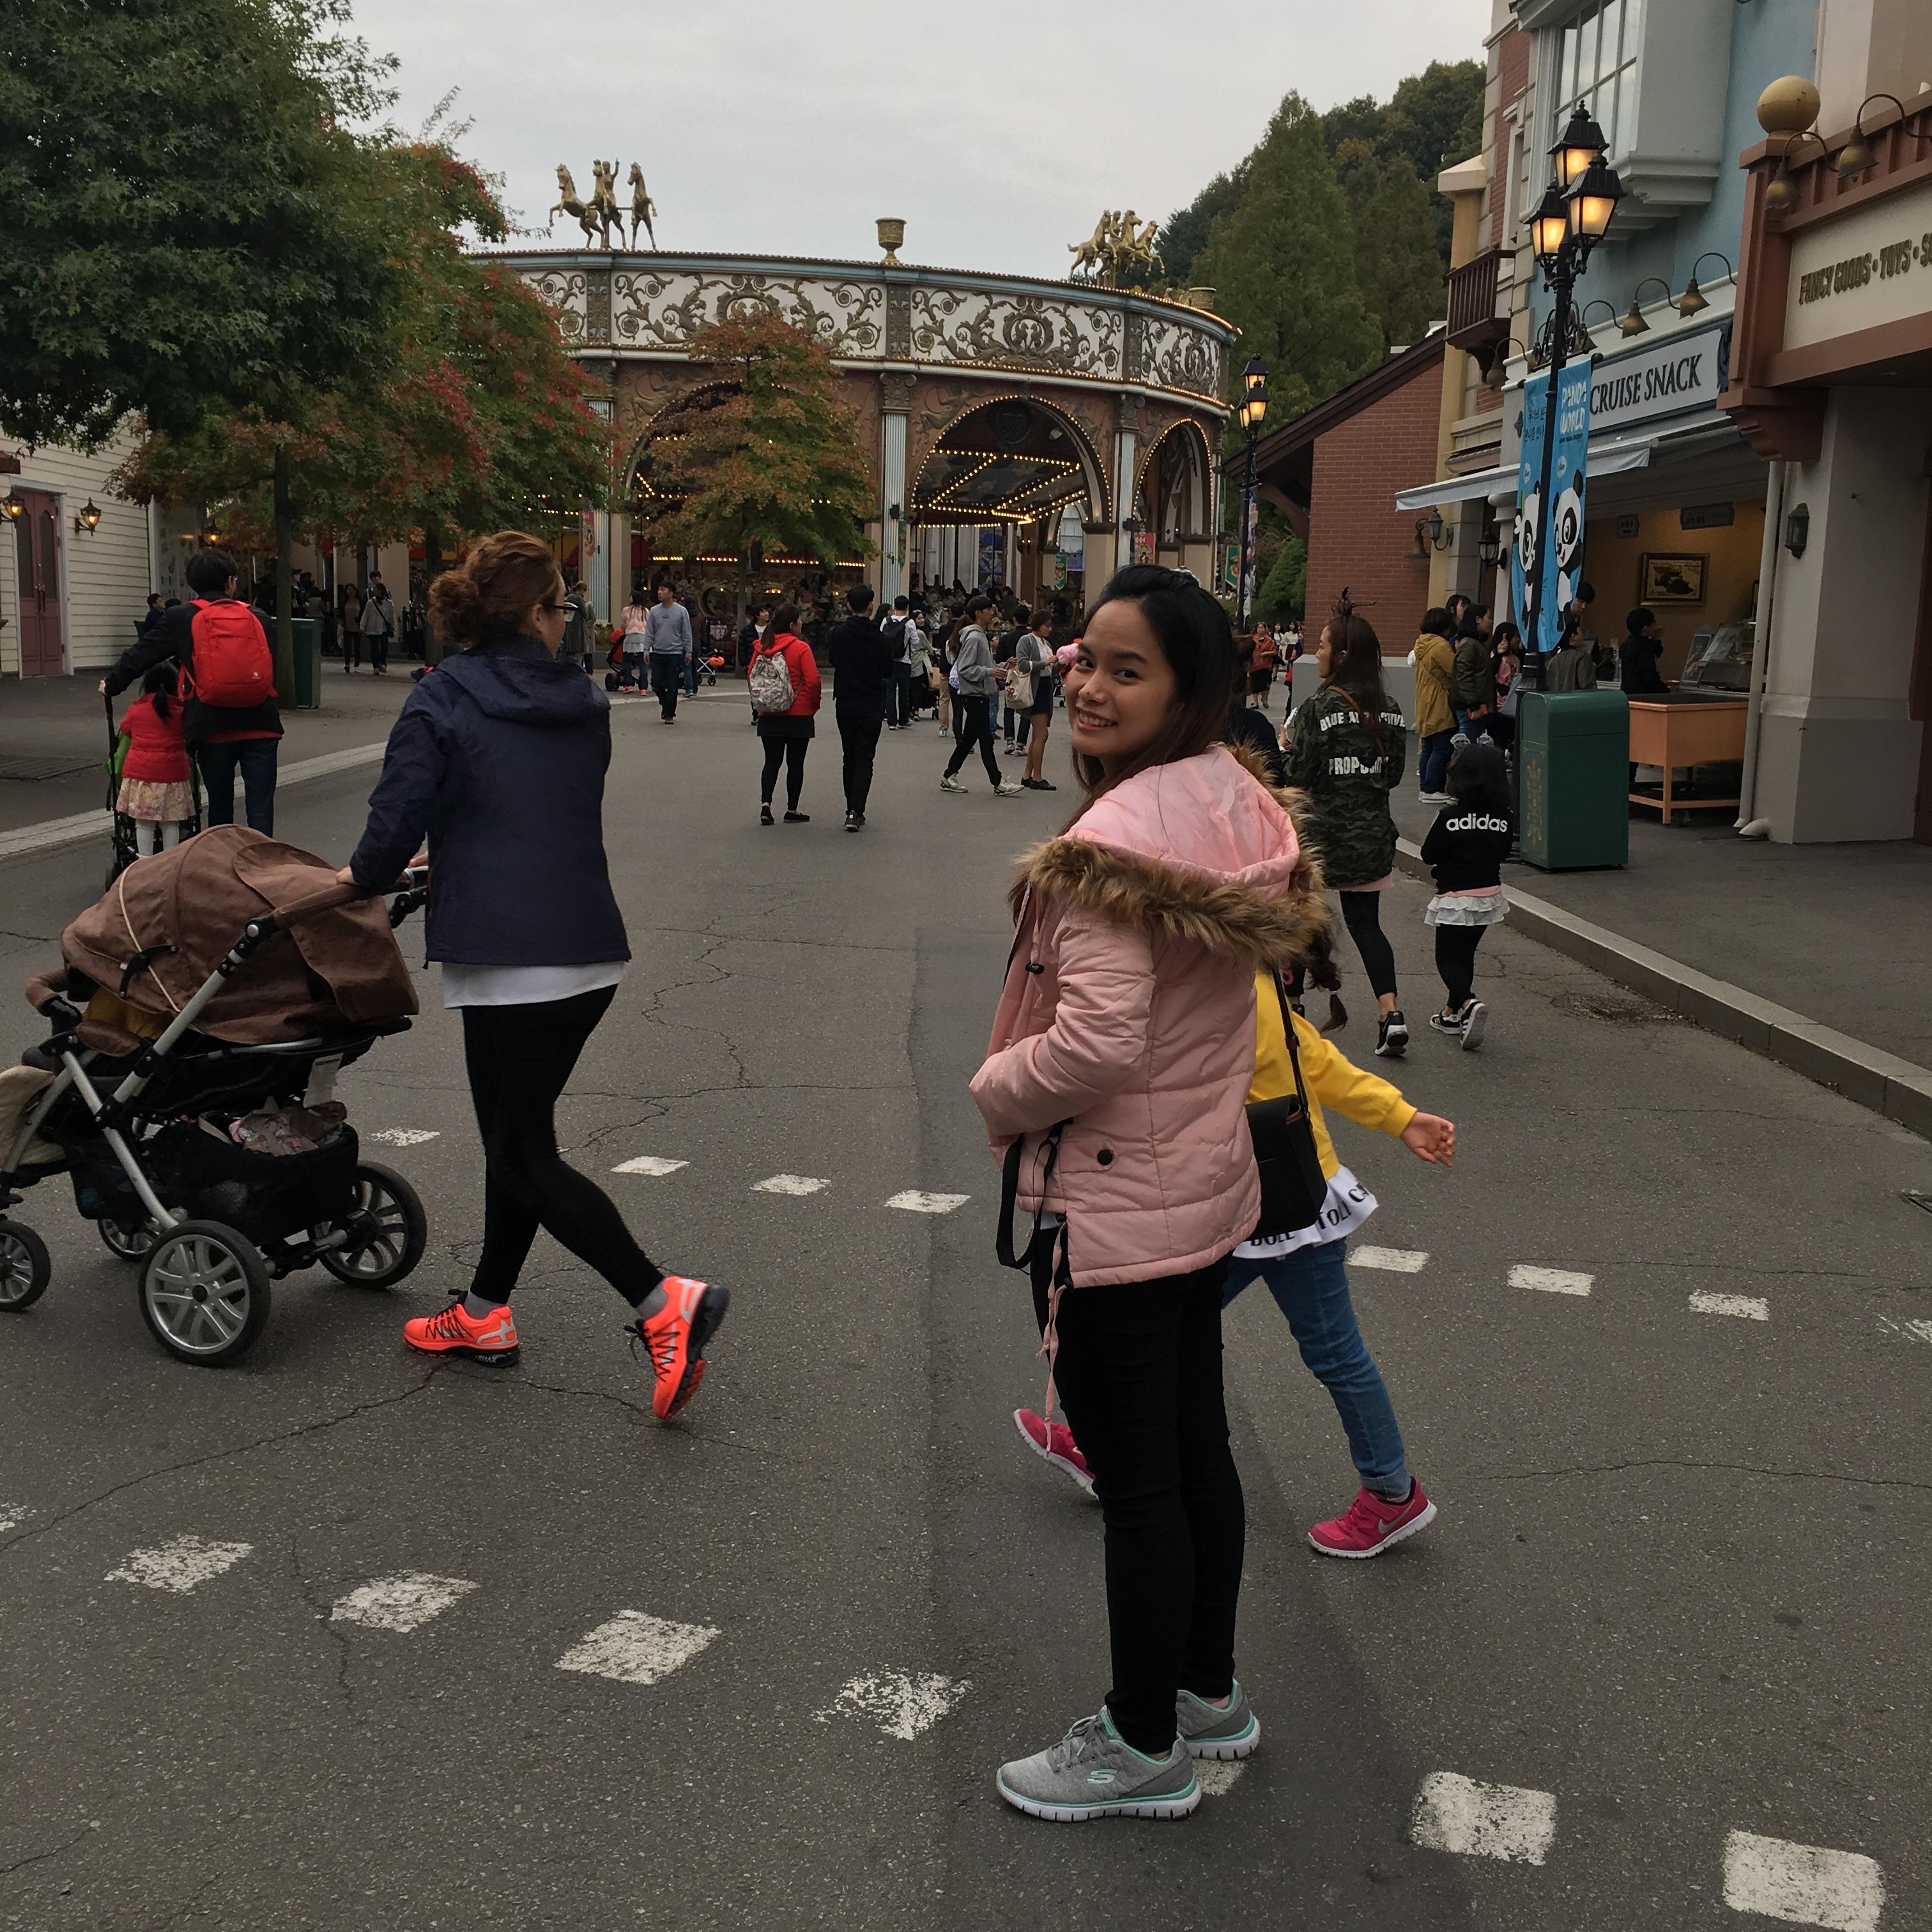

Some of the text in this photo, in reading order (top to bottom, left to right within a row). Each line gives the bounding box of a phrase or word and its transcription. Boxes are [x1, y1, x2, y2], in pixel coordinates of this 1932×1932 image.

[1798, 264, 1835, 305] FANCY
[1834, 252, 1873, 294] GOODS
[1880, 239, 1913, 279] TOYS
[1561, 381, 1588, 410] PANDA
[1589, 353, 1703, 415] CRUISE SNACK
[1560, 407, 1586, 435] WORLD
[1446, 813, 1508, 832] adidas
